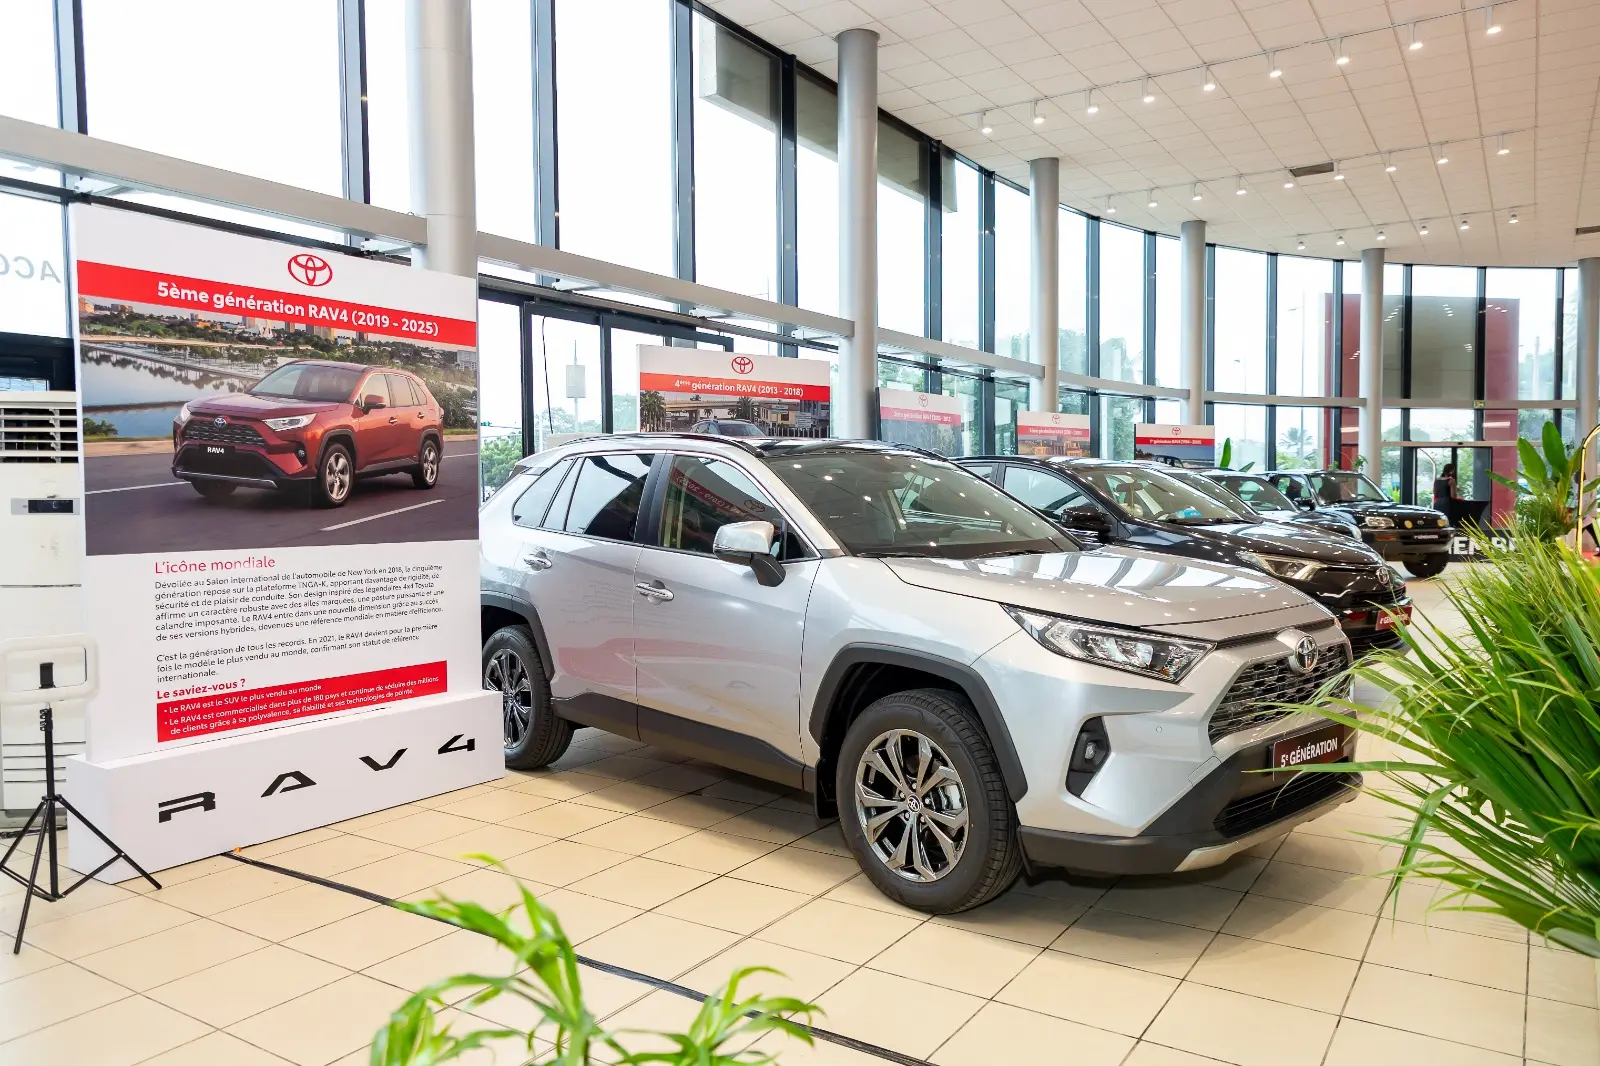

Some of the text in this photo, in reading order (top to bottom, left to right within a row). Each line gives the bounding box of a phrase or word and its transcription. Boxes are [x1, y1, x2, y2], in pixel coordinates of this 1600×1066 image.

[157, 281, 209, 303] 5ème
[213, 290, 306, 315] génération
[309, 304, 348, 324] RAV4
[352, 309, 390, 331] (2019
[402, 317, 439, 337] 2025)
[692, 382, 735, 392] génération
[737, 384, 756, 393] RAV4
[758, 386, 778, 395] (2013
[784, 387, 803, 396] 2018)
[155, 556, 275, 573] L'icône mondiale
[155, 579, 192, 588] Dévoilée
[206, 576, 228, 585] Salon
[230, 572, 279, 583] international
[292, 569, 336, 579] l'automobile
[363, 567, 377, 575] York
[154, 589, 201, 601] génération
[203, 588, 231, 597] repose
[255, 583, 296, 594] plateforme
[155, 599, 189, 609] sécurité
[214, 595, 238, 607] plaisir
[252, 592, 286, 602] conduite.
[304, 589, 327, 598] design
[329, 586, 351, 597] inspiré
[155, 611, 185, 620] affirme
[200, 606, 237, 616] caractère
[239, 604, 269, 613] robuste
[304, 599, 319, 607] ailes
[371, 593, 395, 603] posture
[155, 620, 193, 630] calandre
[195, 616, 239, 628] imposante.
[252, 612, 272, 621] RAV4
[328, 604, 357, 614] nouvelle
[185, 629, 218, 638] versions
[220, 625, 256, 636] hybrides,
[258, 621, 293, 631] devenues
[343, 611, 374, 621] mondiale
[156, 653, 177, 661] C'est
[189, 647, 233, 660] génération
[278, 639, 306, 649] records.
[319, 635, 336, 644] 2021,
[345, 631, 362, 640] RAV4
[364, 628, 388, 638] devient
[389, 628, 403, 637] pour
[157, 664, 172, 672] fois
[184, 658, 215, 669] modèle
[226, 656, 243, 666] plus
[245, 652, 268, 662] vendu
[281, 648, 308, 657] monde,
[310, 642, 347, 654] confirmant
[362, 638, 381, 647] statut
[156, 678, 245, 699] Le saviez-vous ?
[157, 669, 218, 683] internationale.
[181, 701, 200, 711] RAV4
[203, 700, 213, 708] est
[225, 695, 239, 704] SUV
[250, 693, 264, 703] plus
[267, 689, 287, 698] vendu
[299, 683, 321, 693] monde
[181, 713, 201, 723] RAV4
[203, 711, 214, 720] est
[216, 702, 267, 718] commercialisé
[287, 698, 301, 708] plus
[313, 693, 323, 702] 180
[348, 686, 374, 696] continue
[182, 722, 208, 732] clients
[248, 710, 291, 724] polyvalence,
[346, 692, 385, 705] technologies
[1290, 737, 1338, 765] GÉNÉRATION
